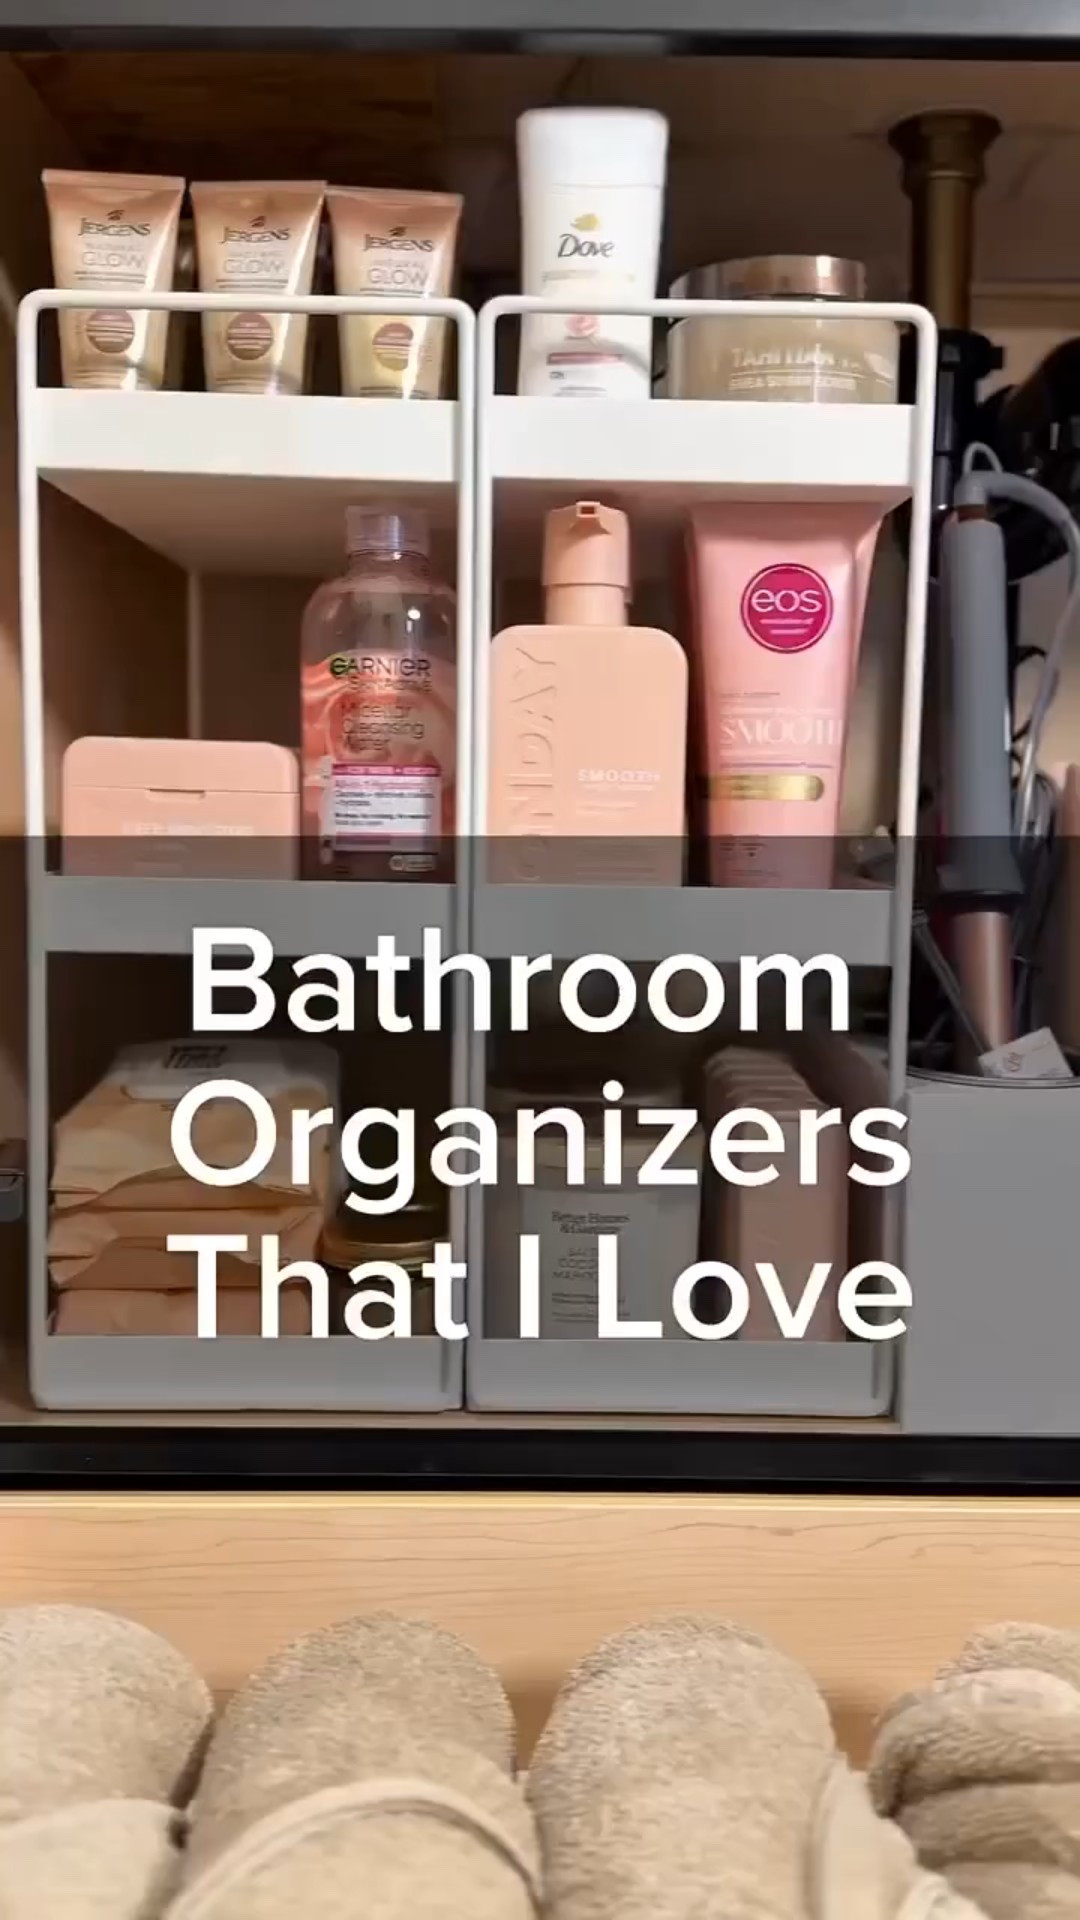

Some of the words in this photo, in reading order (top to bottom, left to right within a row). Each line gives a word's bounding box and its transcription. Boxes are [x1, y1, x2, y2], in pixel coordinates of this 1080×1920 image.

[78, 217, 151, 237] JERGENS
[219, 226, 290, 245] JERGENS
[361, 233, 434, 252] JERGENS
[557, 232, 615, 258] Dove
[82, 251, 145, 269] GLOW
[223, 258, 285, 276] GLOW
[368, 267, 429, 287] GLOW
[750, 588, 823, 613] eos
[329, 656, 432, 680] GARNIER
[342, 717, 424, 740] Cleansing
[577, 768, 661, 783] SMOOTH
